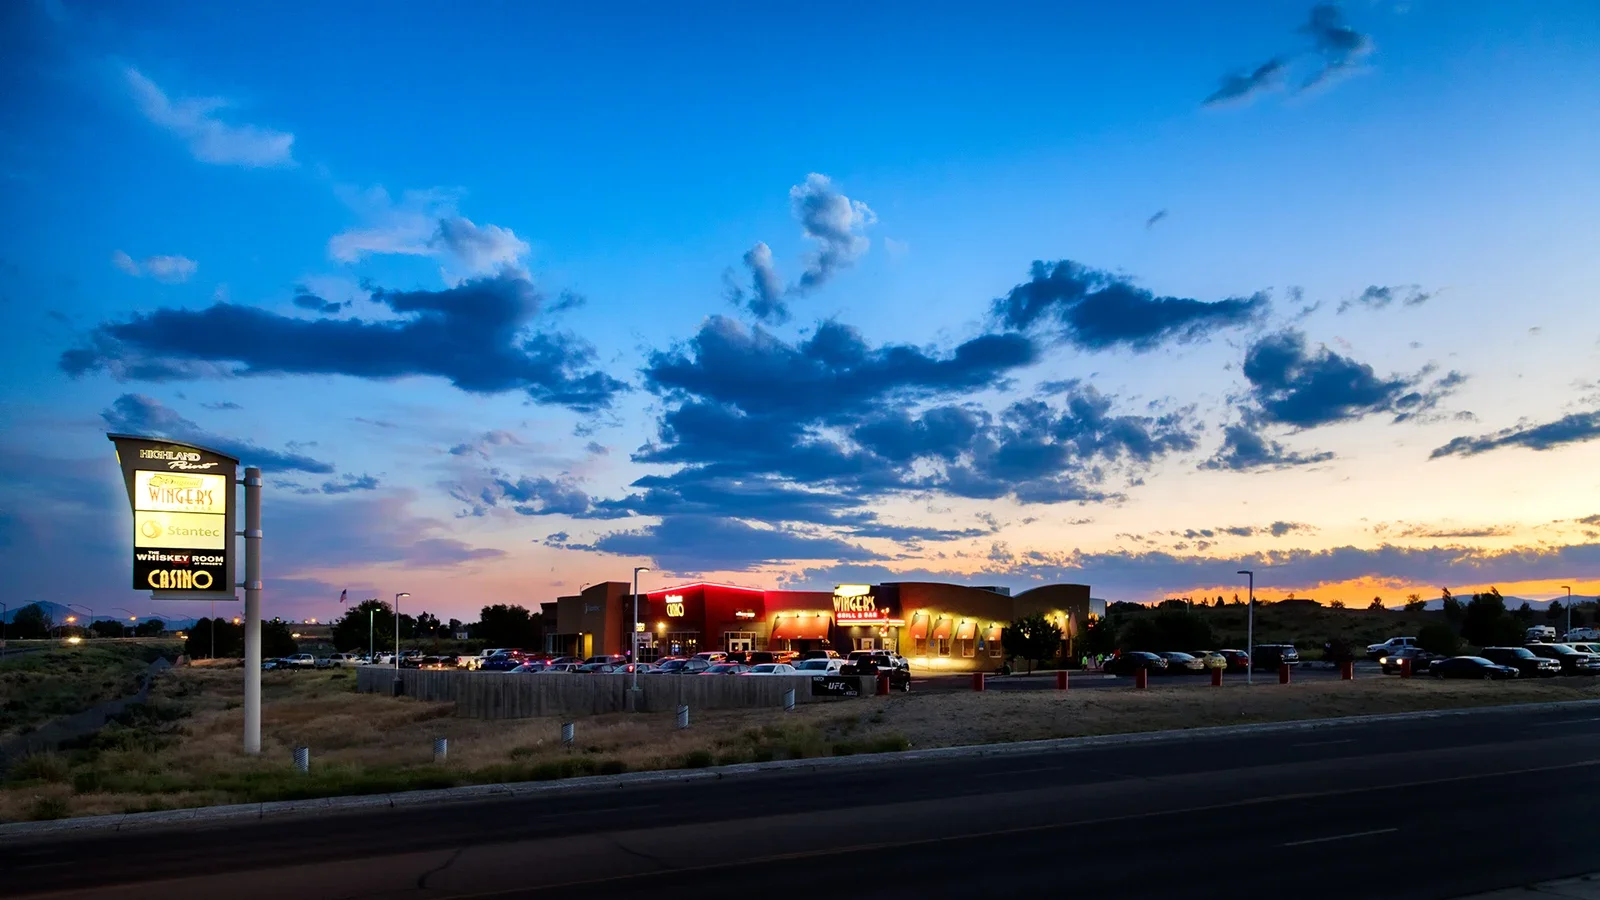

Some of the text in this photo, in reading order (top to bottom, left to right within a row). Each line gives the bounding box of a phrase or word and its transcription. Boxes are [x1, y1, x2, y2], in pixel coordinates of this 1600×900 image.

[140, 449, 201, 461] HIGHLAND
[149, 487, 213, 506] WINGER'S
[168, 525, 219, 537] Stantec
[136, 554, 224, 563] WHISKEY ROOM
[147, 569, 213, 589] CASINO
[833, 595, 876, 612] WINGER'S
[828, 682, 846, 690] UFC
